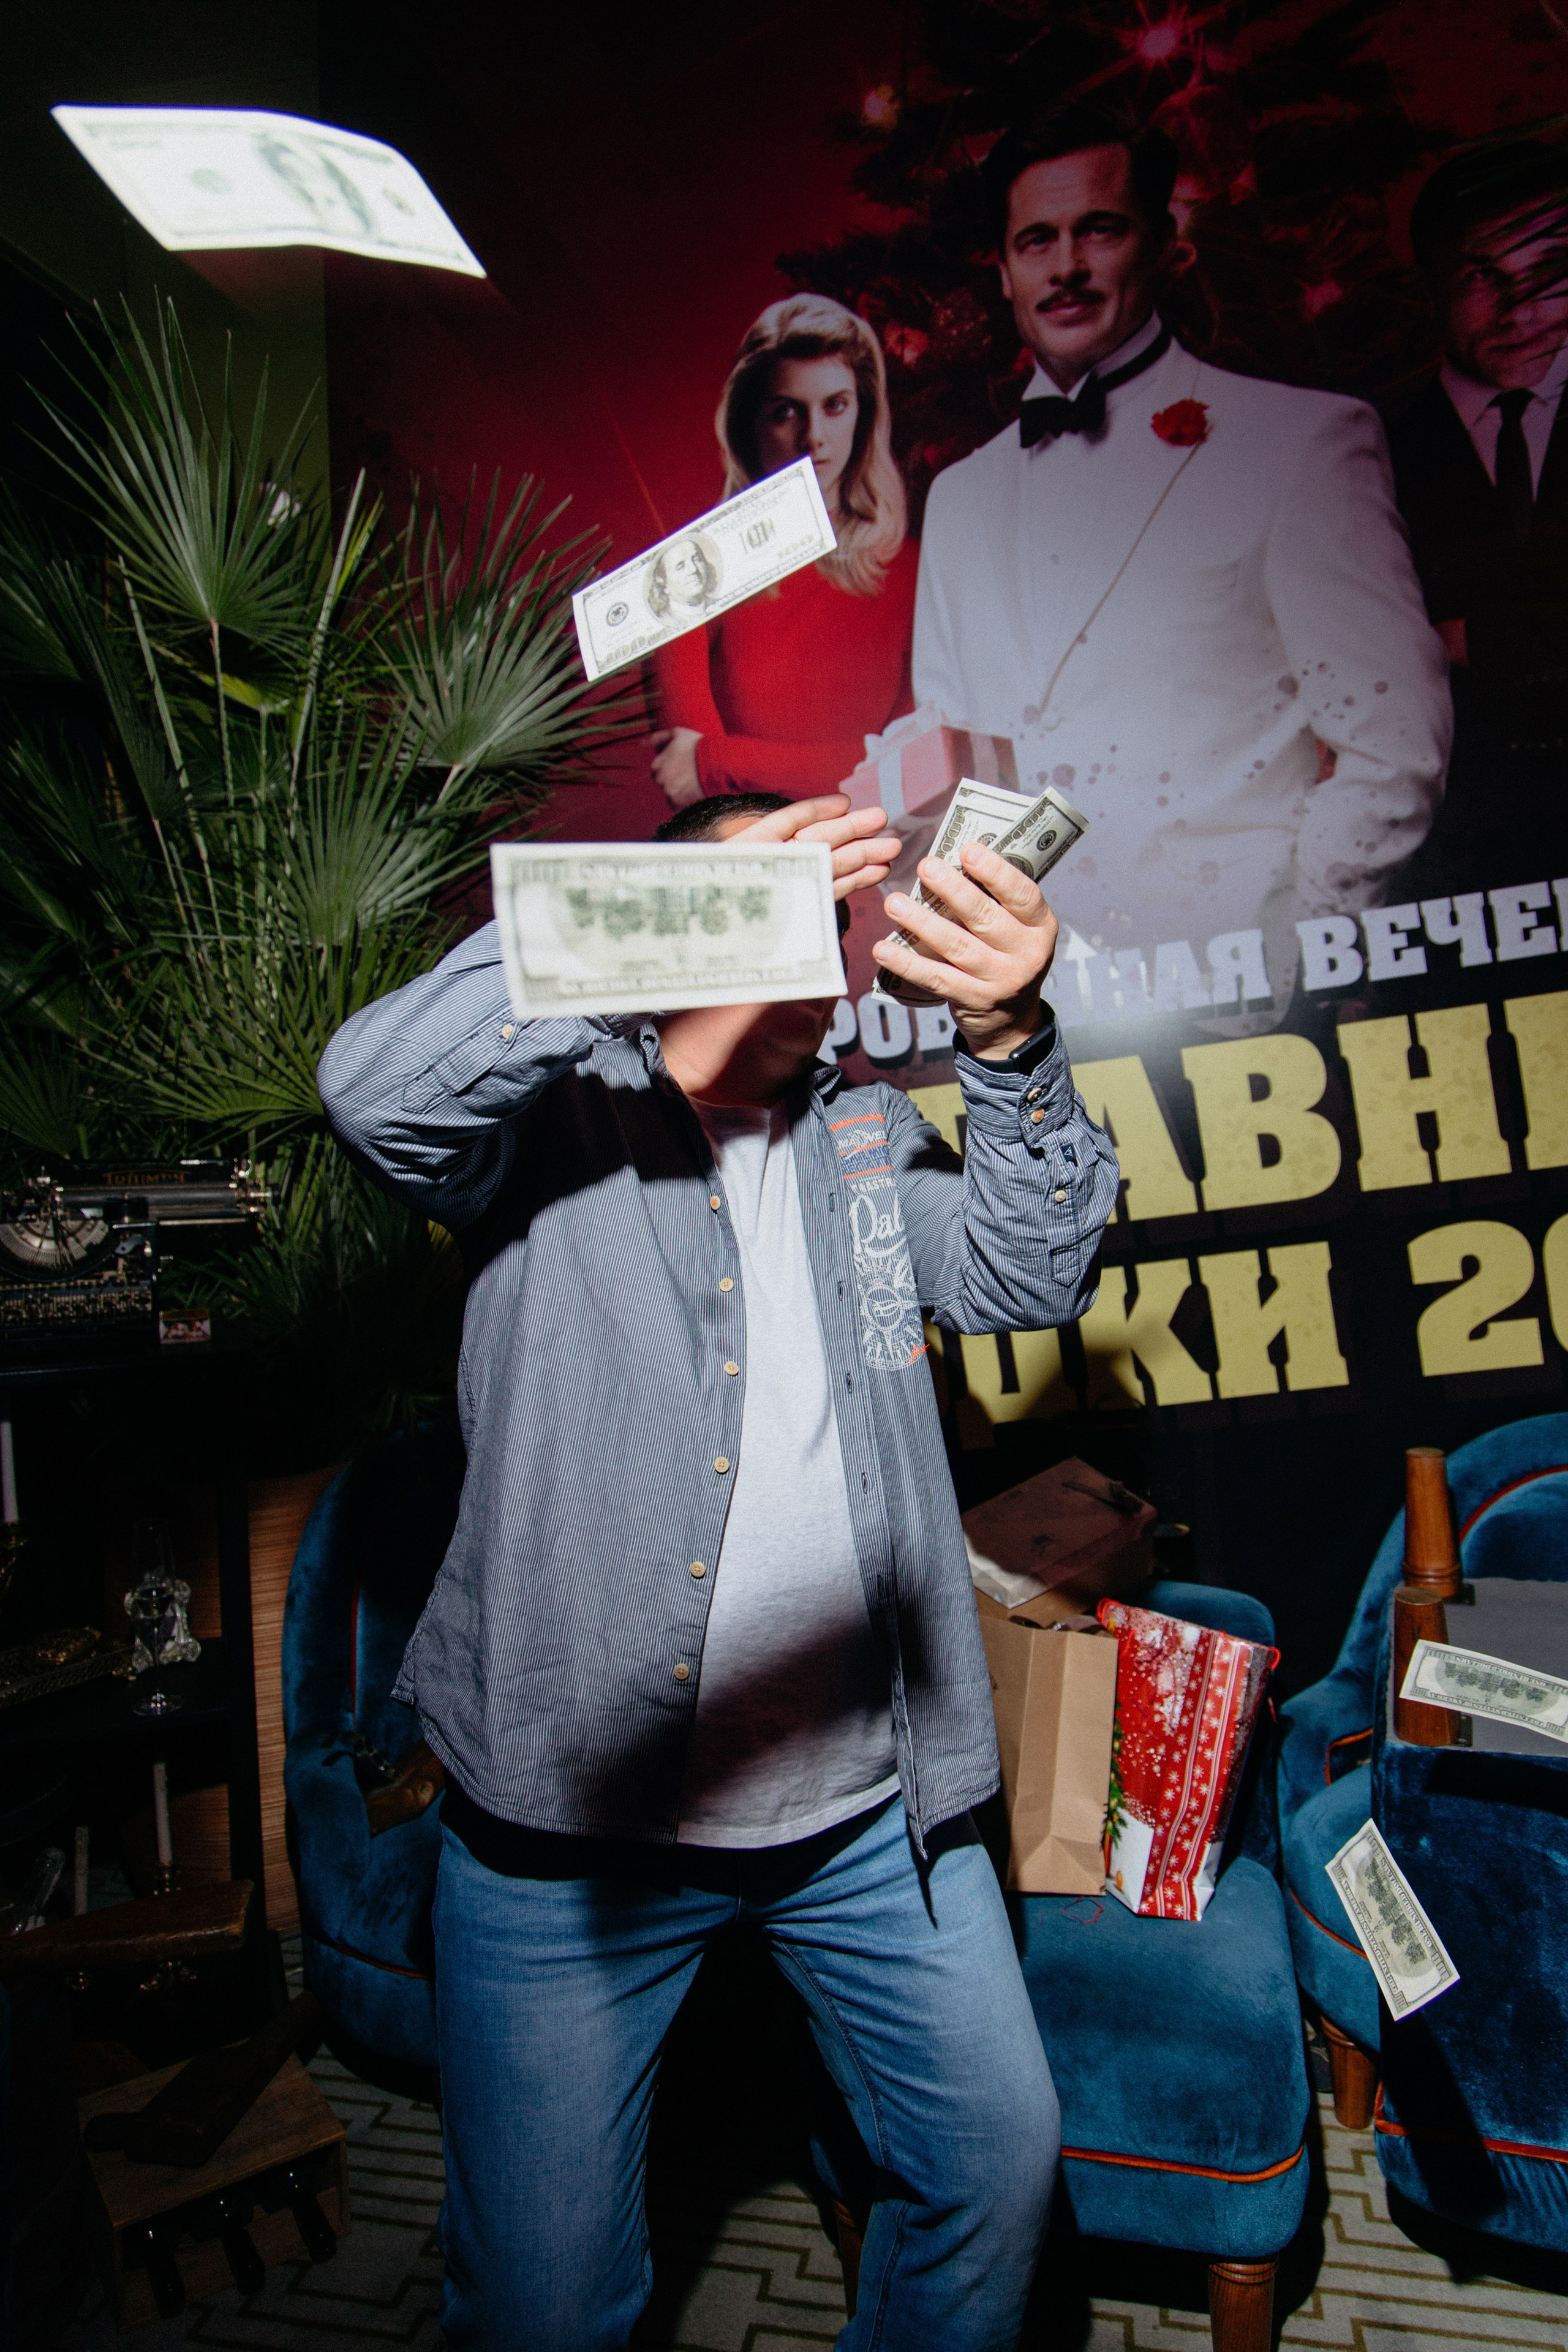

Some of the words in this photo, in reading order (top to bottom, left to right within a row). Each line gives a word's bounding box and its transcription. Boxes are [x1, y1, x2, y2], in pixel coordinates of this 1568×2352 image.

[1296, 878, 1568, 992] ВЕЧЕ
[907, 991, 1568, 1225] АВН
[1408, 1214, 1568, 1377] 2
